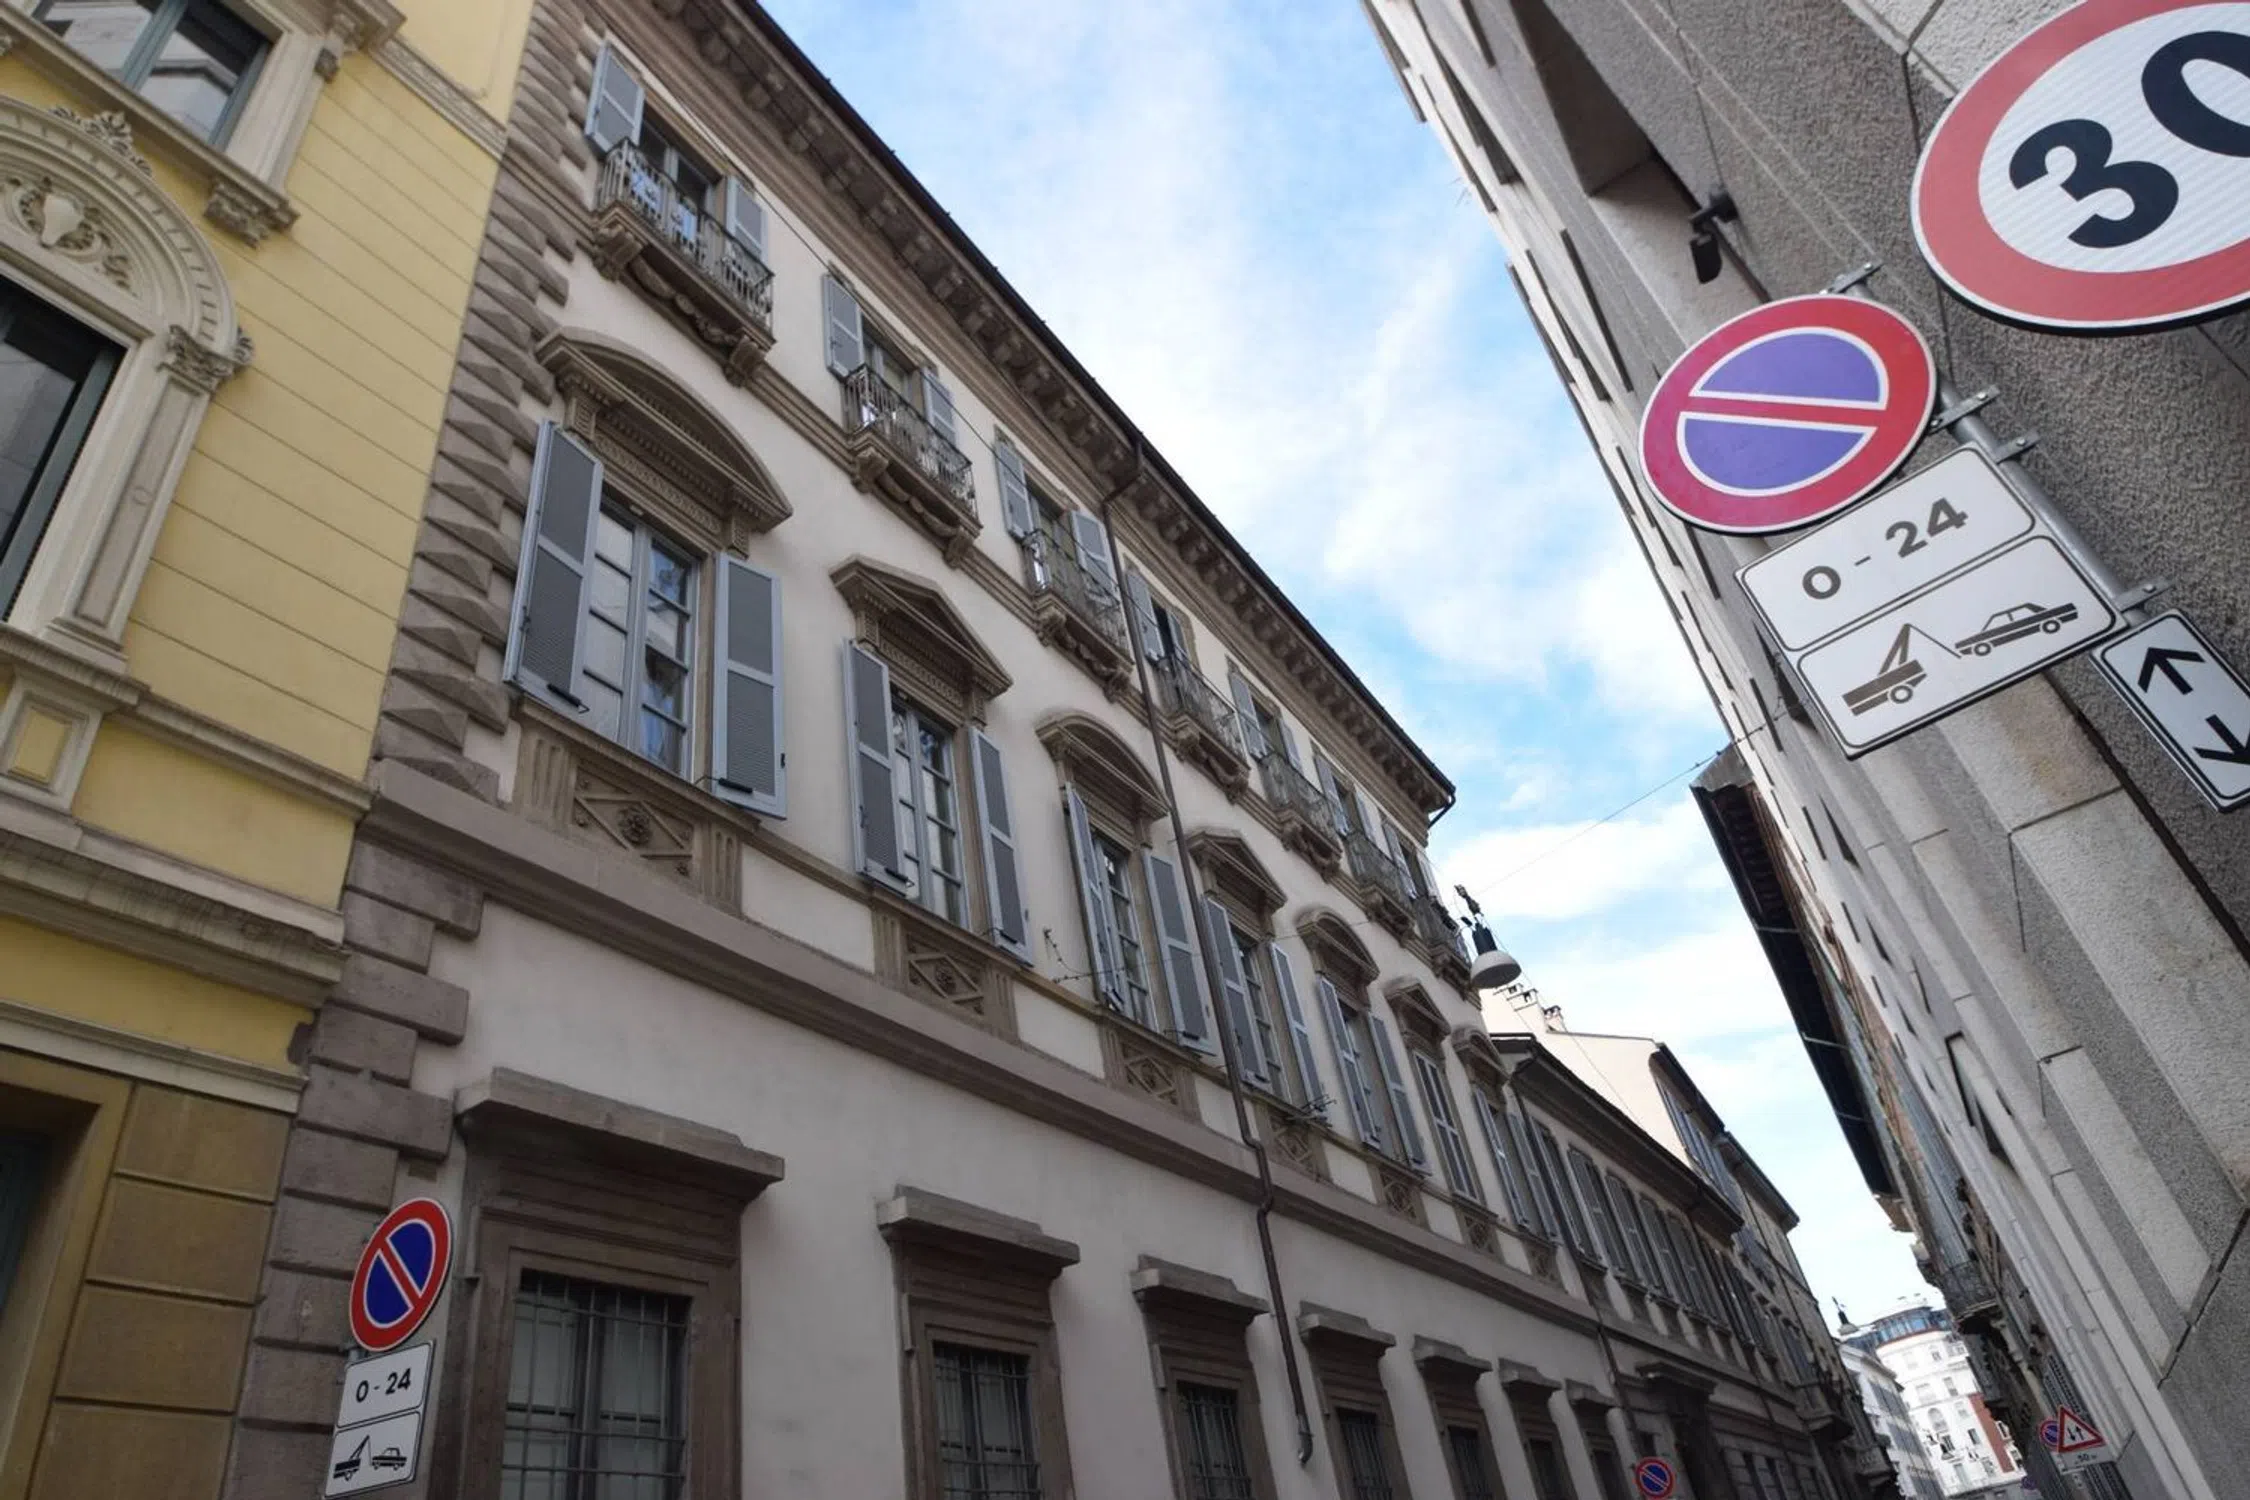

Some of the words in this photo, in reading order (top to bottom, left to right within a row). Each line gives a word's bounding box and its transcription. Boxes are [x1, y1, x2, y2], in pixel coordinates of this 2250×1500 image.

[2009, 31, 2250, 248] 30
[1802, 566, 1841, 599] 0
[1885, 497, 1968, 558] 24
[356, 1380, 369, 1402] 0
[385, 1368, 411, 1395] 24
